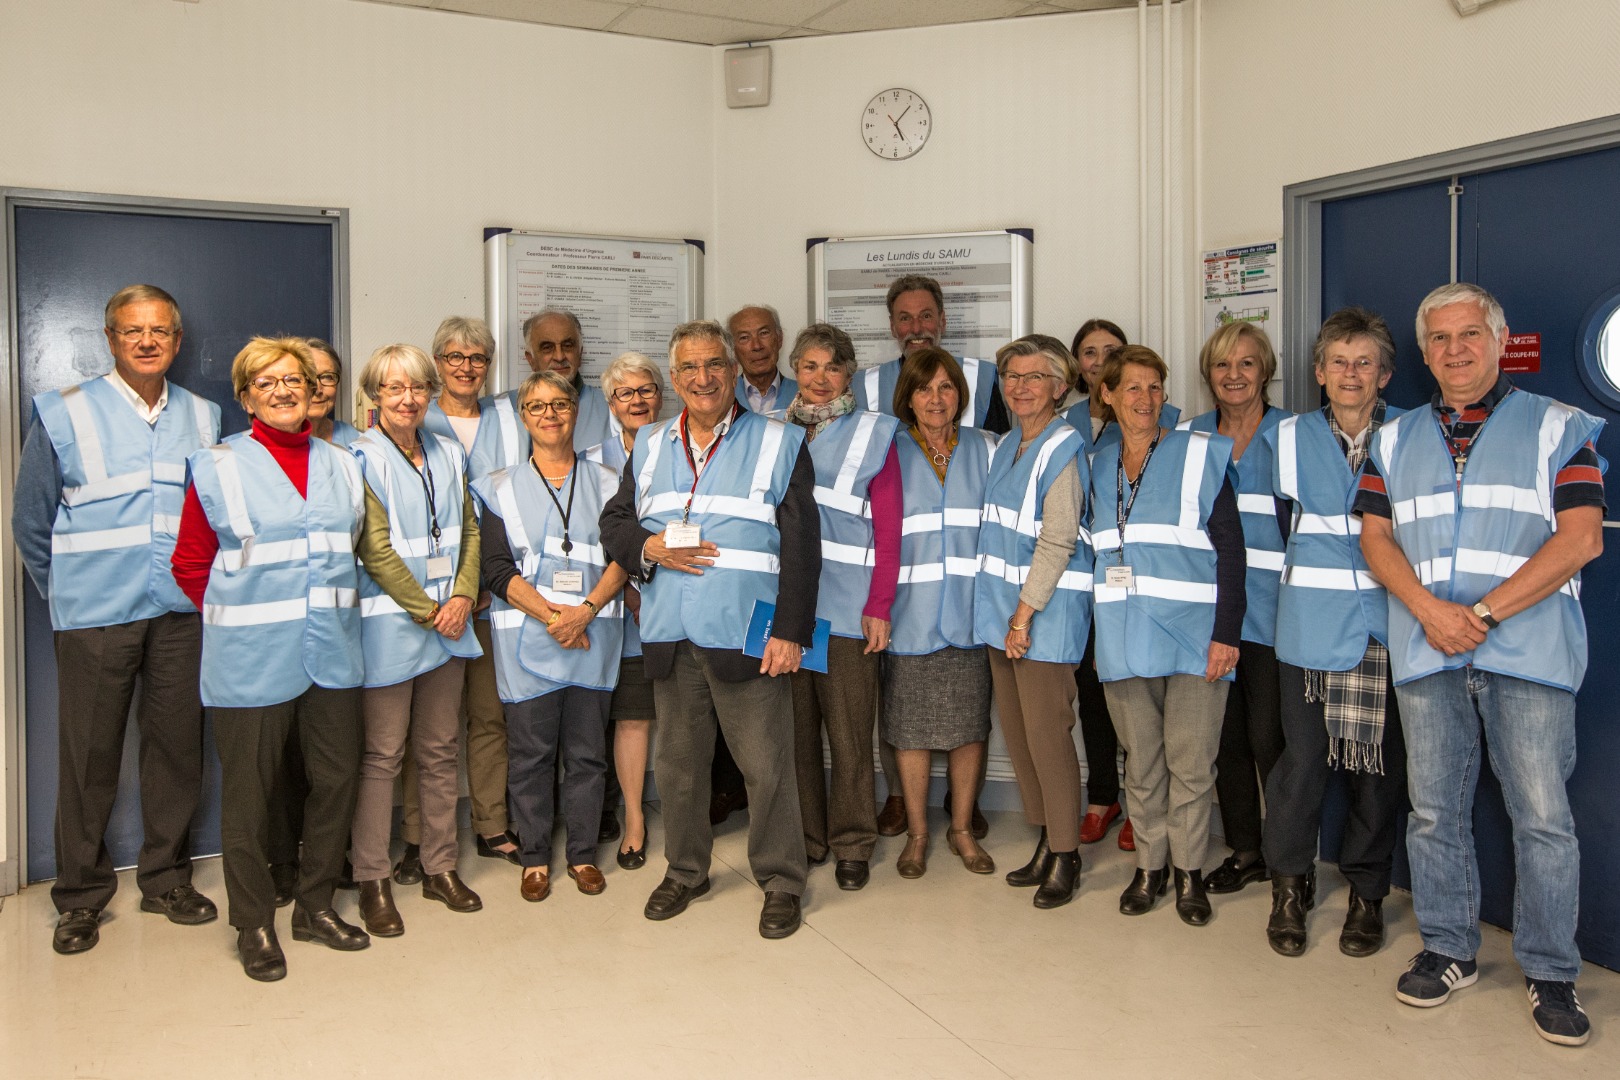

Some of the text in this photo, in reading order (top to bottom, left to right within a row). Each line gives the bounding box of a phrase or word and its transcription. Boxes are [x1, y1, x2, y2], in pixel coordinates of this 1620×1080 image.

[867, 248, 971, 262] Les Lundis du SAMU
[1226, 248, 1248, 256] Consignes
